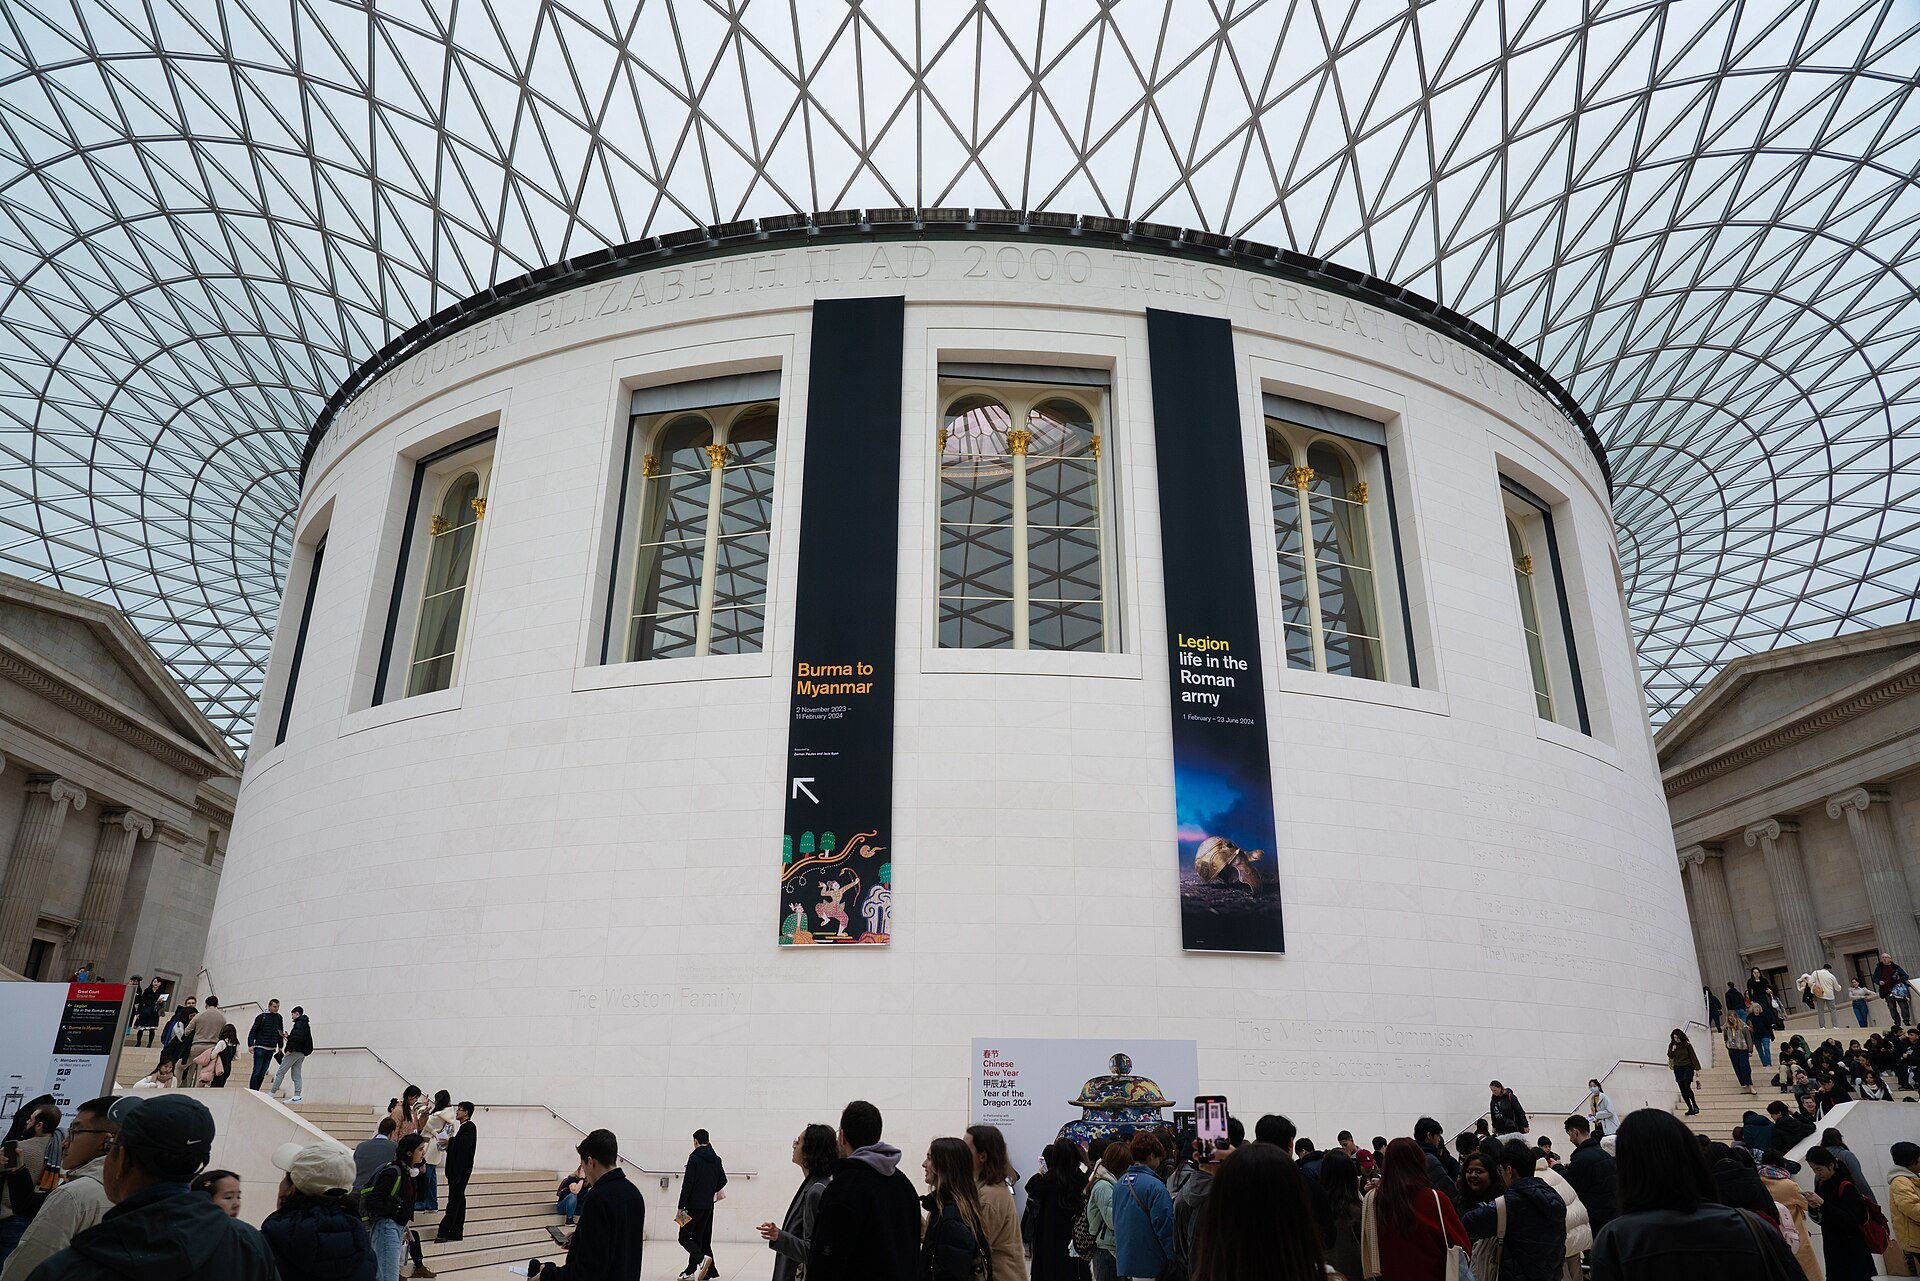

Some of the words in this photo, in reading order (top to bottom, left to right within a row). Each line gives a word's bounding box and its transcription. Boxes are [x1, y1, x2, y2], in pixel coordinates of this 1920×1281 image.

[411, 312, 517, 388] QUEEN
[530, 252, 785, 338] ELIZABETH
[805, 248, 841, 285] II
[858, 245, 936, 281] AD
[962, 244, 1093, 284] 2000
[1112, 253, 1226, 301] THIS
[1247, 274, 1387, 344] GREAT
[1402, 322, 1504, 397] COURT
[1178, 633, 1230, 652] Legion
[797, 662, 853, 677] Burma
[856, 661, 874, 676] to
[1179, 652, 1202, 667] life
[1206, 654, 1219, 668] in
[1223, 655, 1248, 671] the
[1180, 669, 1235, 688] Roman
[796, 680, 873, 698] Myanmar
[1181, 691, 1220, 707] army
[802, 713, 827, 721] February
[1187, 713, 1212, 723] February
[1239, 717, 1255, 725] 2024
[568, 988, 597, 1009] The
[604, 988, 673, 1009] Weston
[681, 986, 742, 1014] Family
[1238, 1019, 1271, 1042] The
[1279, 1021, 1376, 1045] Millennium
[1384, 1025, 1476, 1048] Commission
[983, 1049, 999, 1059] 春节
[983, 1060, 1014, 1068] Chinese
[983, 1069, 1000, 1077] New
[1002, 1069, 1019, 1077] Year
[983, 1079, 1016, 1088] 甲辰龙年
[983, 1090, 1000, 1098] Year
[1002, 1090, 1009, 1098] of
[1011, 1090, 1024, 1098] the
[982, 1099, 1011, 1108] Dragon
[1013, 1099, 1032, 1107] 2024
